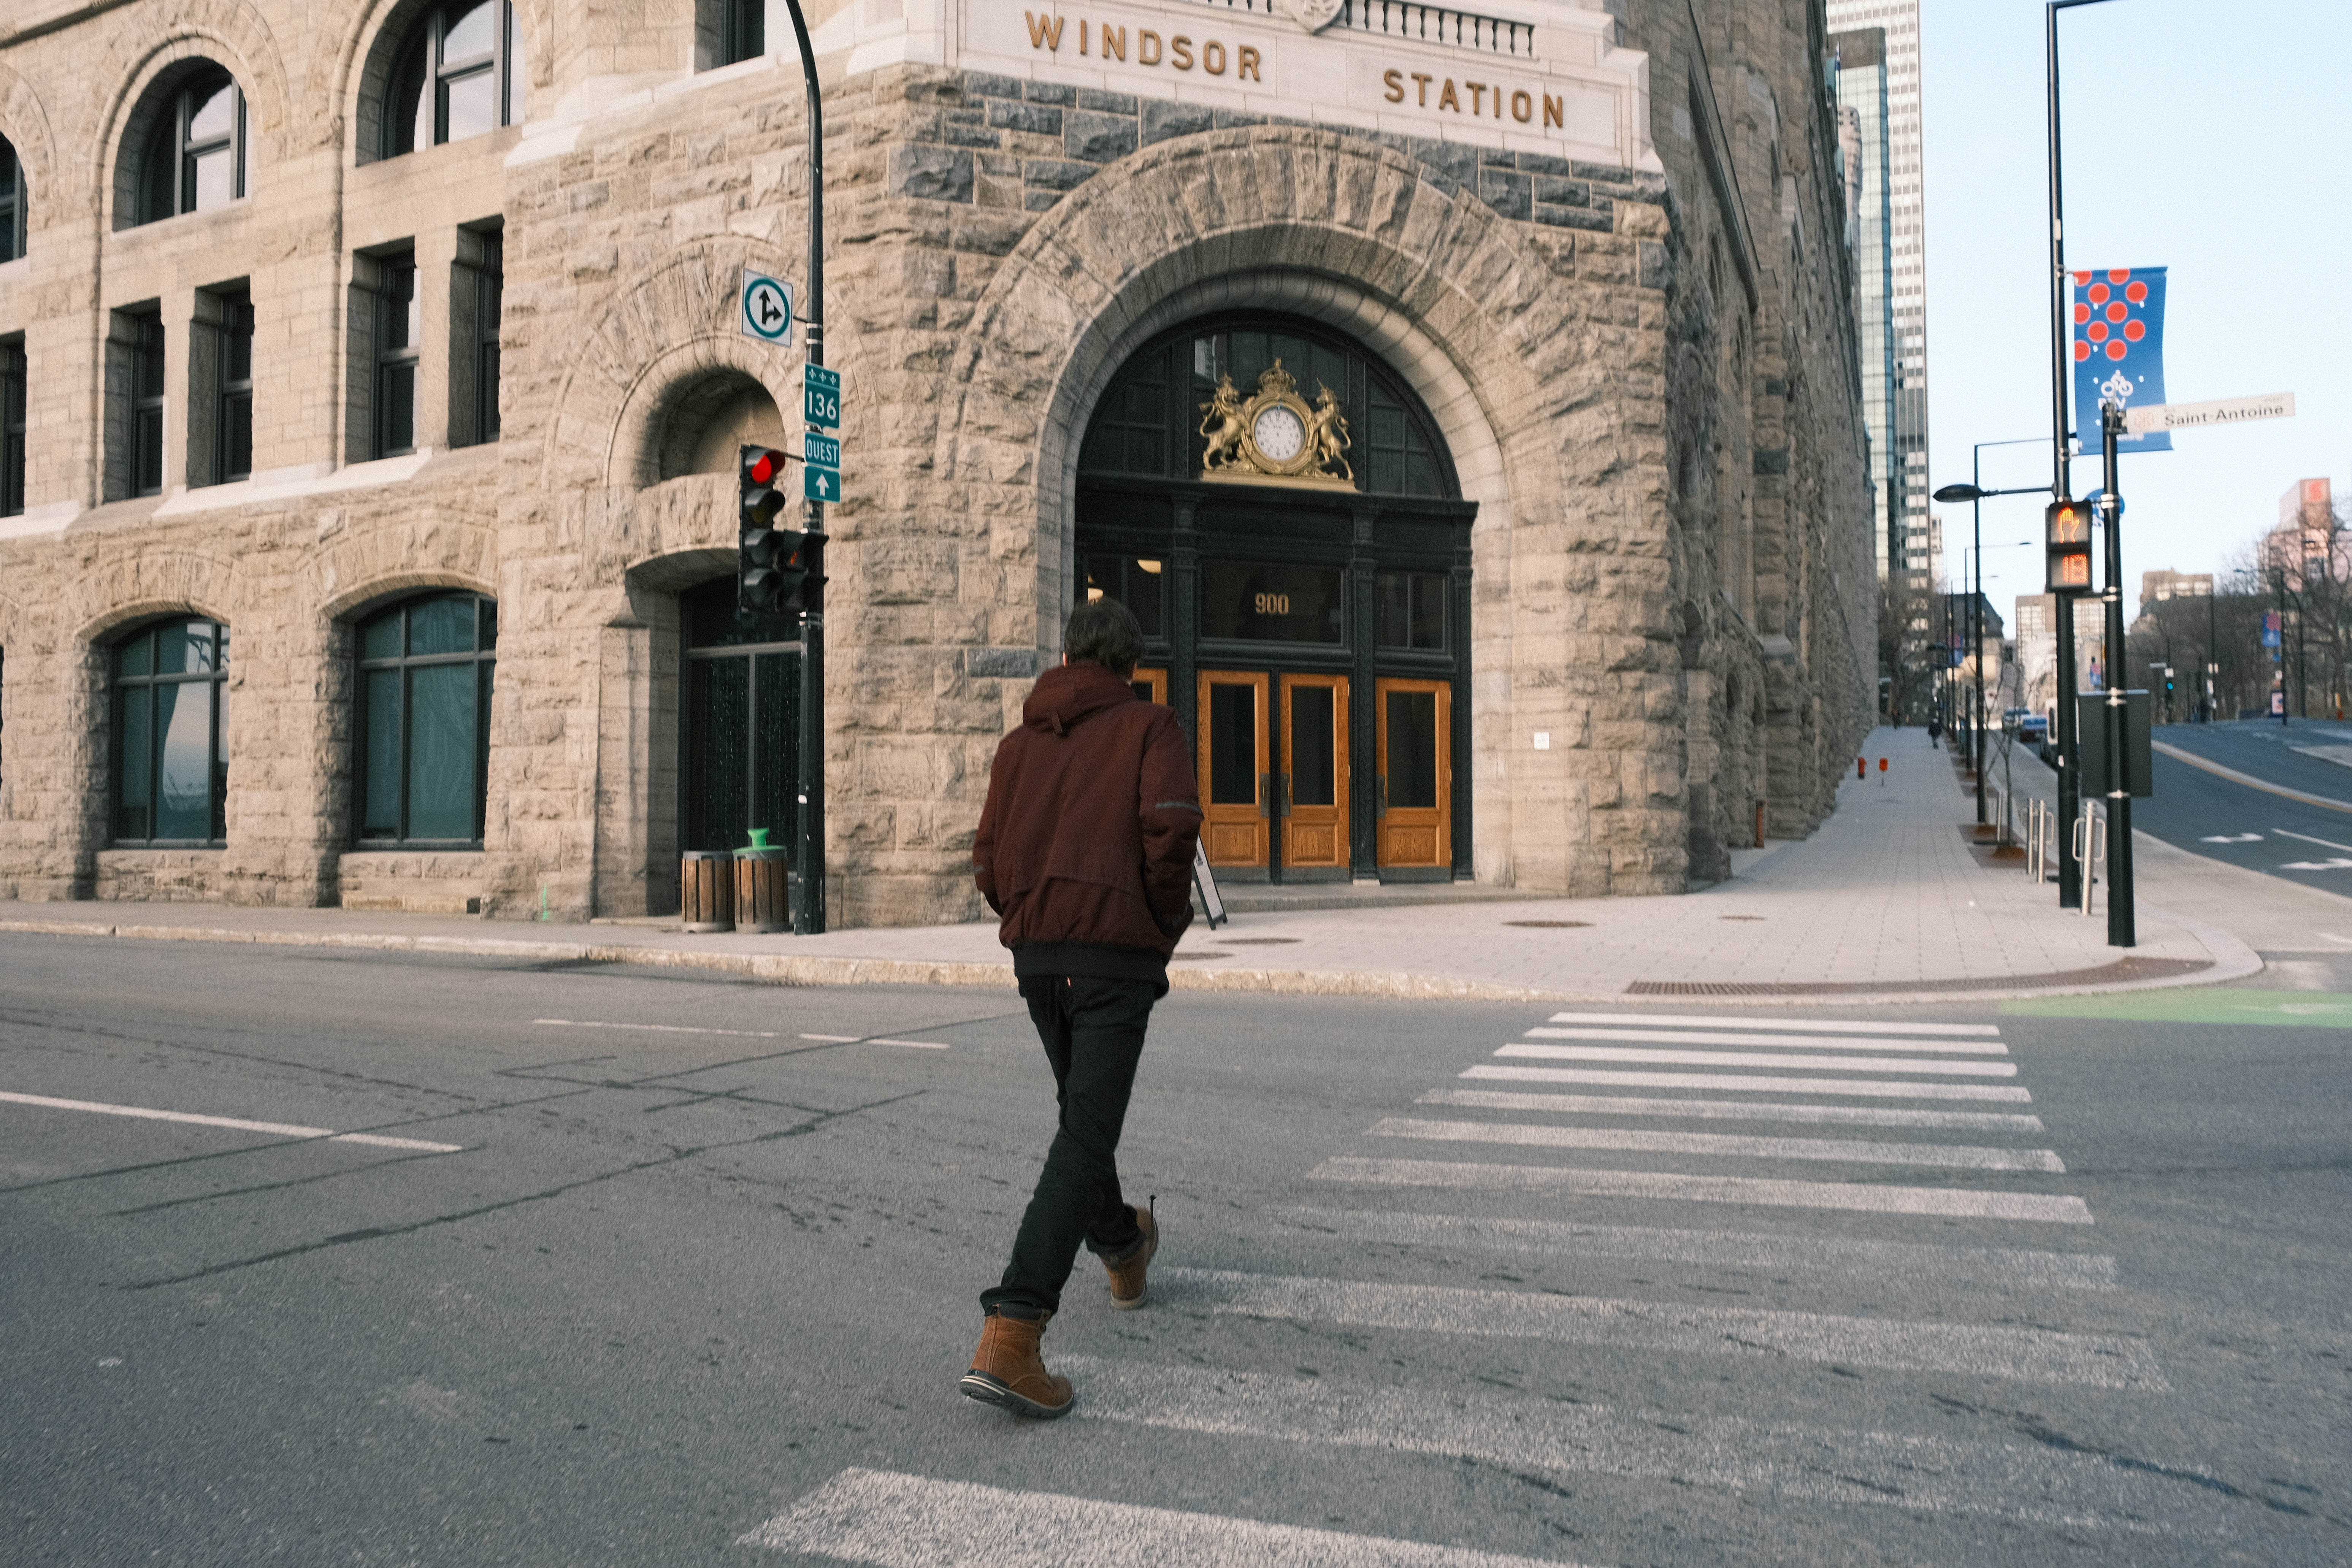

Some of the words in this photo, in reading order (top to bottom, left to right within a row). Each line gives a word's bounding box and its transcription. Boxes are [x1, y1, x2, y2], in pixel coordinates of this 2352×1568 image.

[1025, 10, 1260, 81] WINDSOR
[1384, 68, 1563, 128] STATION
[808, 391, 837, 421] 136
[806, 438, 838, 463] OUEST
[1256, 593, 1289, 615] 900
